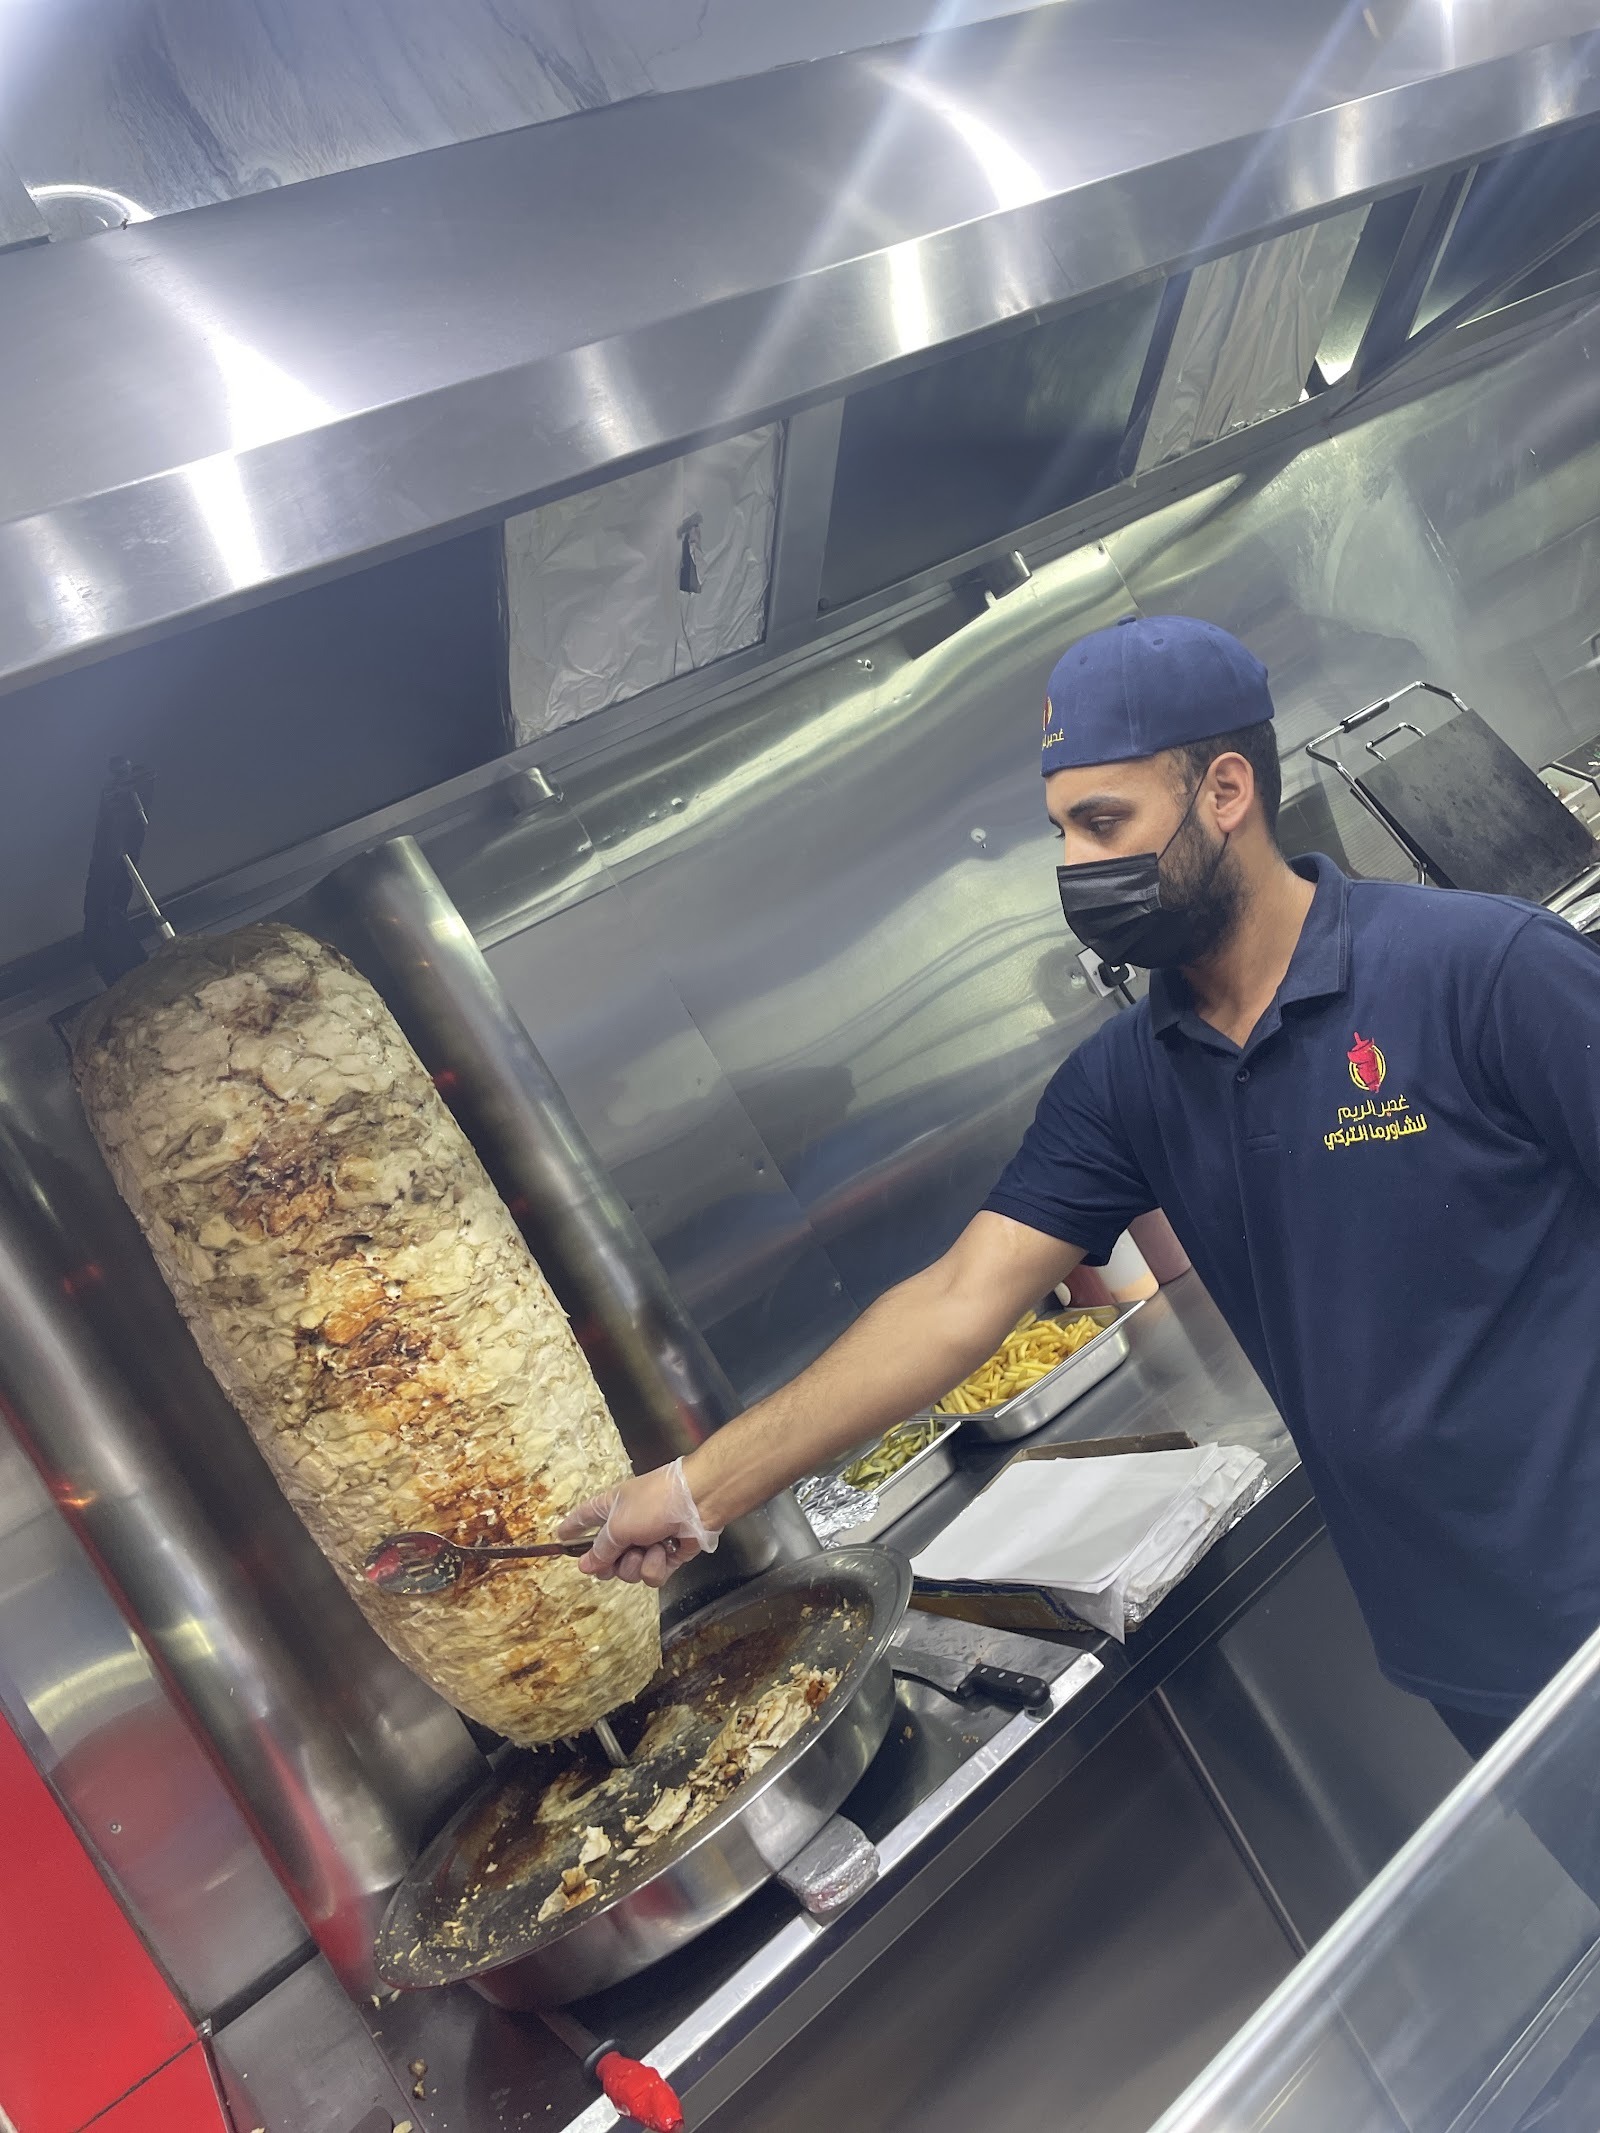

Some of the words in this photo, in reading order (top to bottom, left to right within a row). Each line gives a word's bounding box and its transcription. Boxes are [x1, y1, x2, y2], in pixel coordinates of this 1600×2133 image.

[1046, 728, 1064, 749] غدير
[1337, 1099, 1376, 1125] الريم
[1374, 1094, 1410, 1118] غدير
[1323, 1123, 1369, 1151] التركي
[1368, 1113, 1428, 1141] للشاورما
